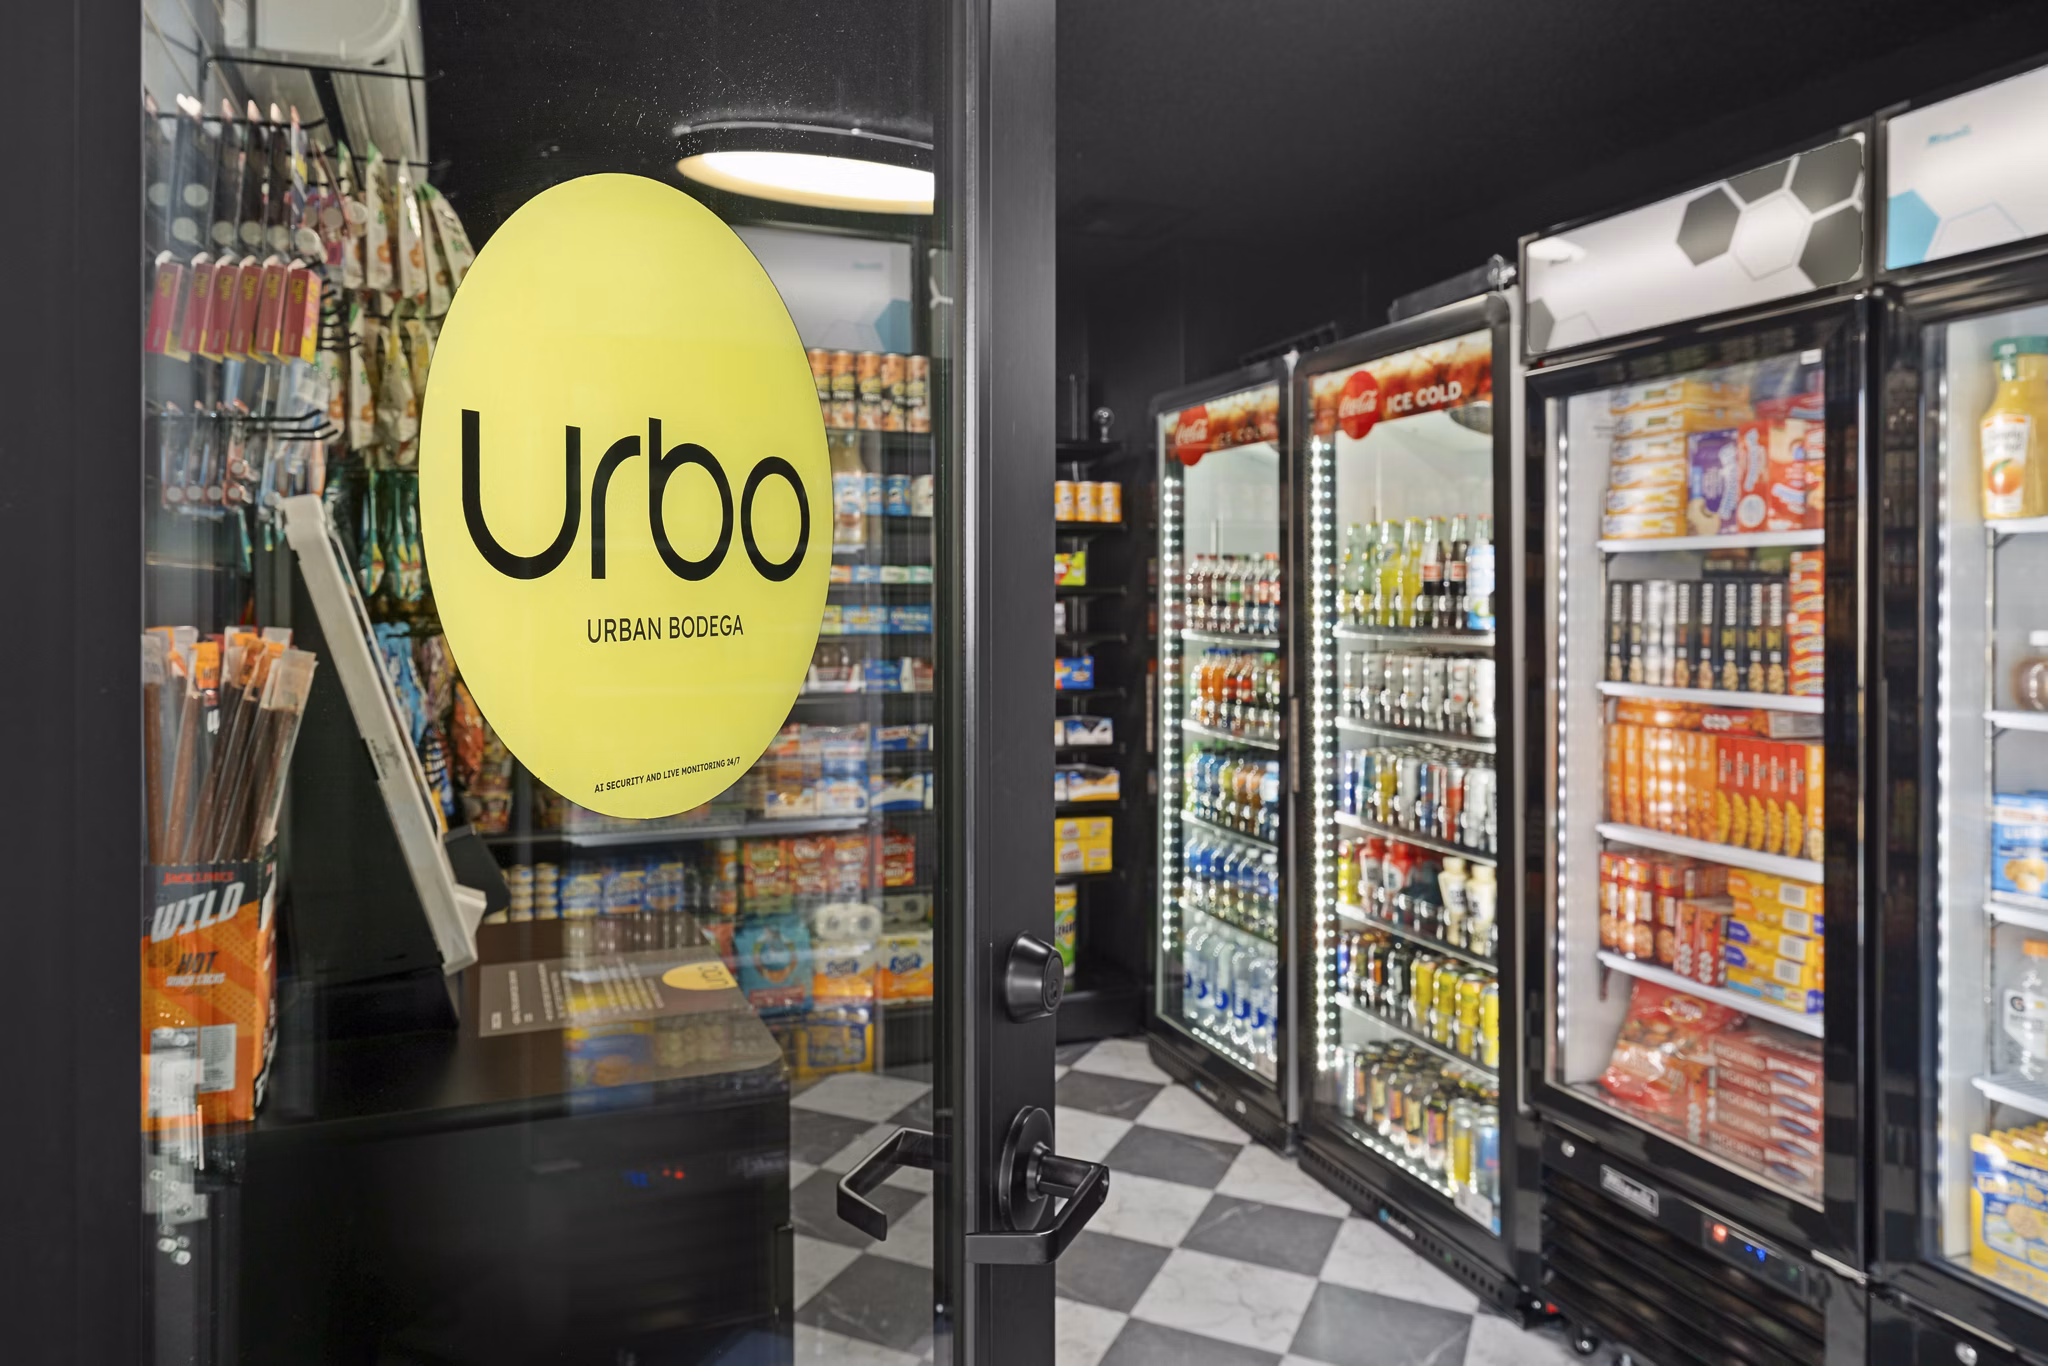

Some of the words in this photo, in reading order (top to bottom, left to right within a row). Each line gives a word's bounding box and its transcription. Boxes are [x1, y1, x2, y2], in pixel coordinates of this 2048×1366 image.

[1387, 392, 1413, 413] ICE
[1416, 381, 1462, 407] COLD
[587, 617, 662, 643] URBAN
[669, 614, 744, 639] BODEGA
[594, 783, 604, 793] AI
[606, 775, 645, 790] SECURITY
[646, 772, 662, 783] AND
[663, 768, 680, 779] LIVE
[681, 759, 726, 775] MONITORING
[726, 756, 741, 768] 24/7
[150, 881, 245, 944] WILD
[176, 951, 219, 975] HOT
